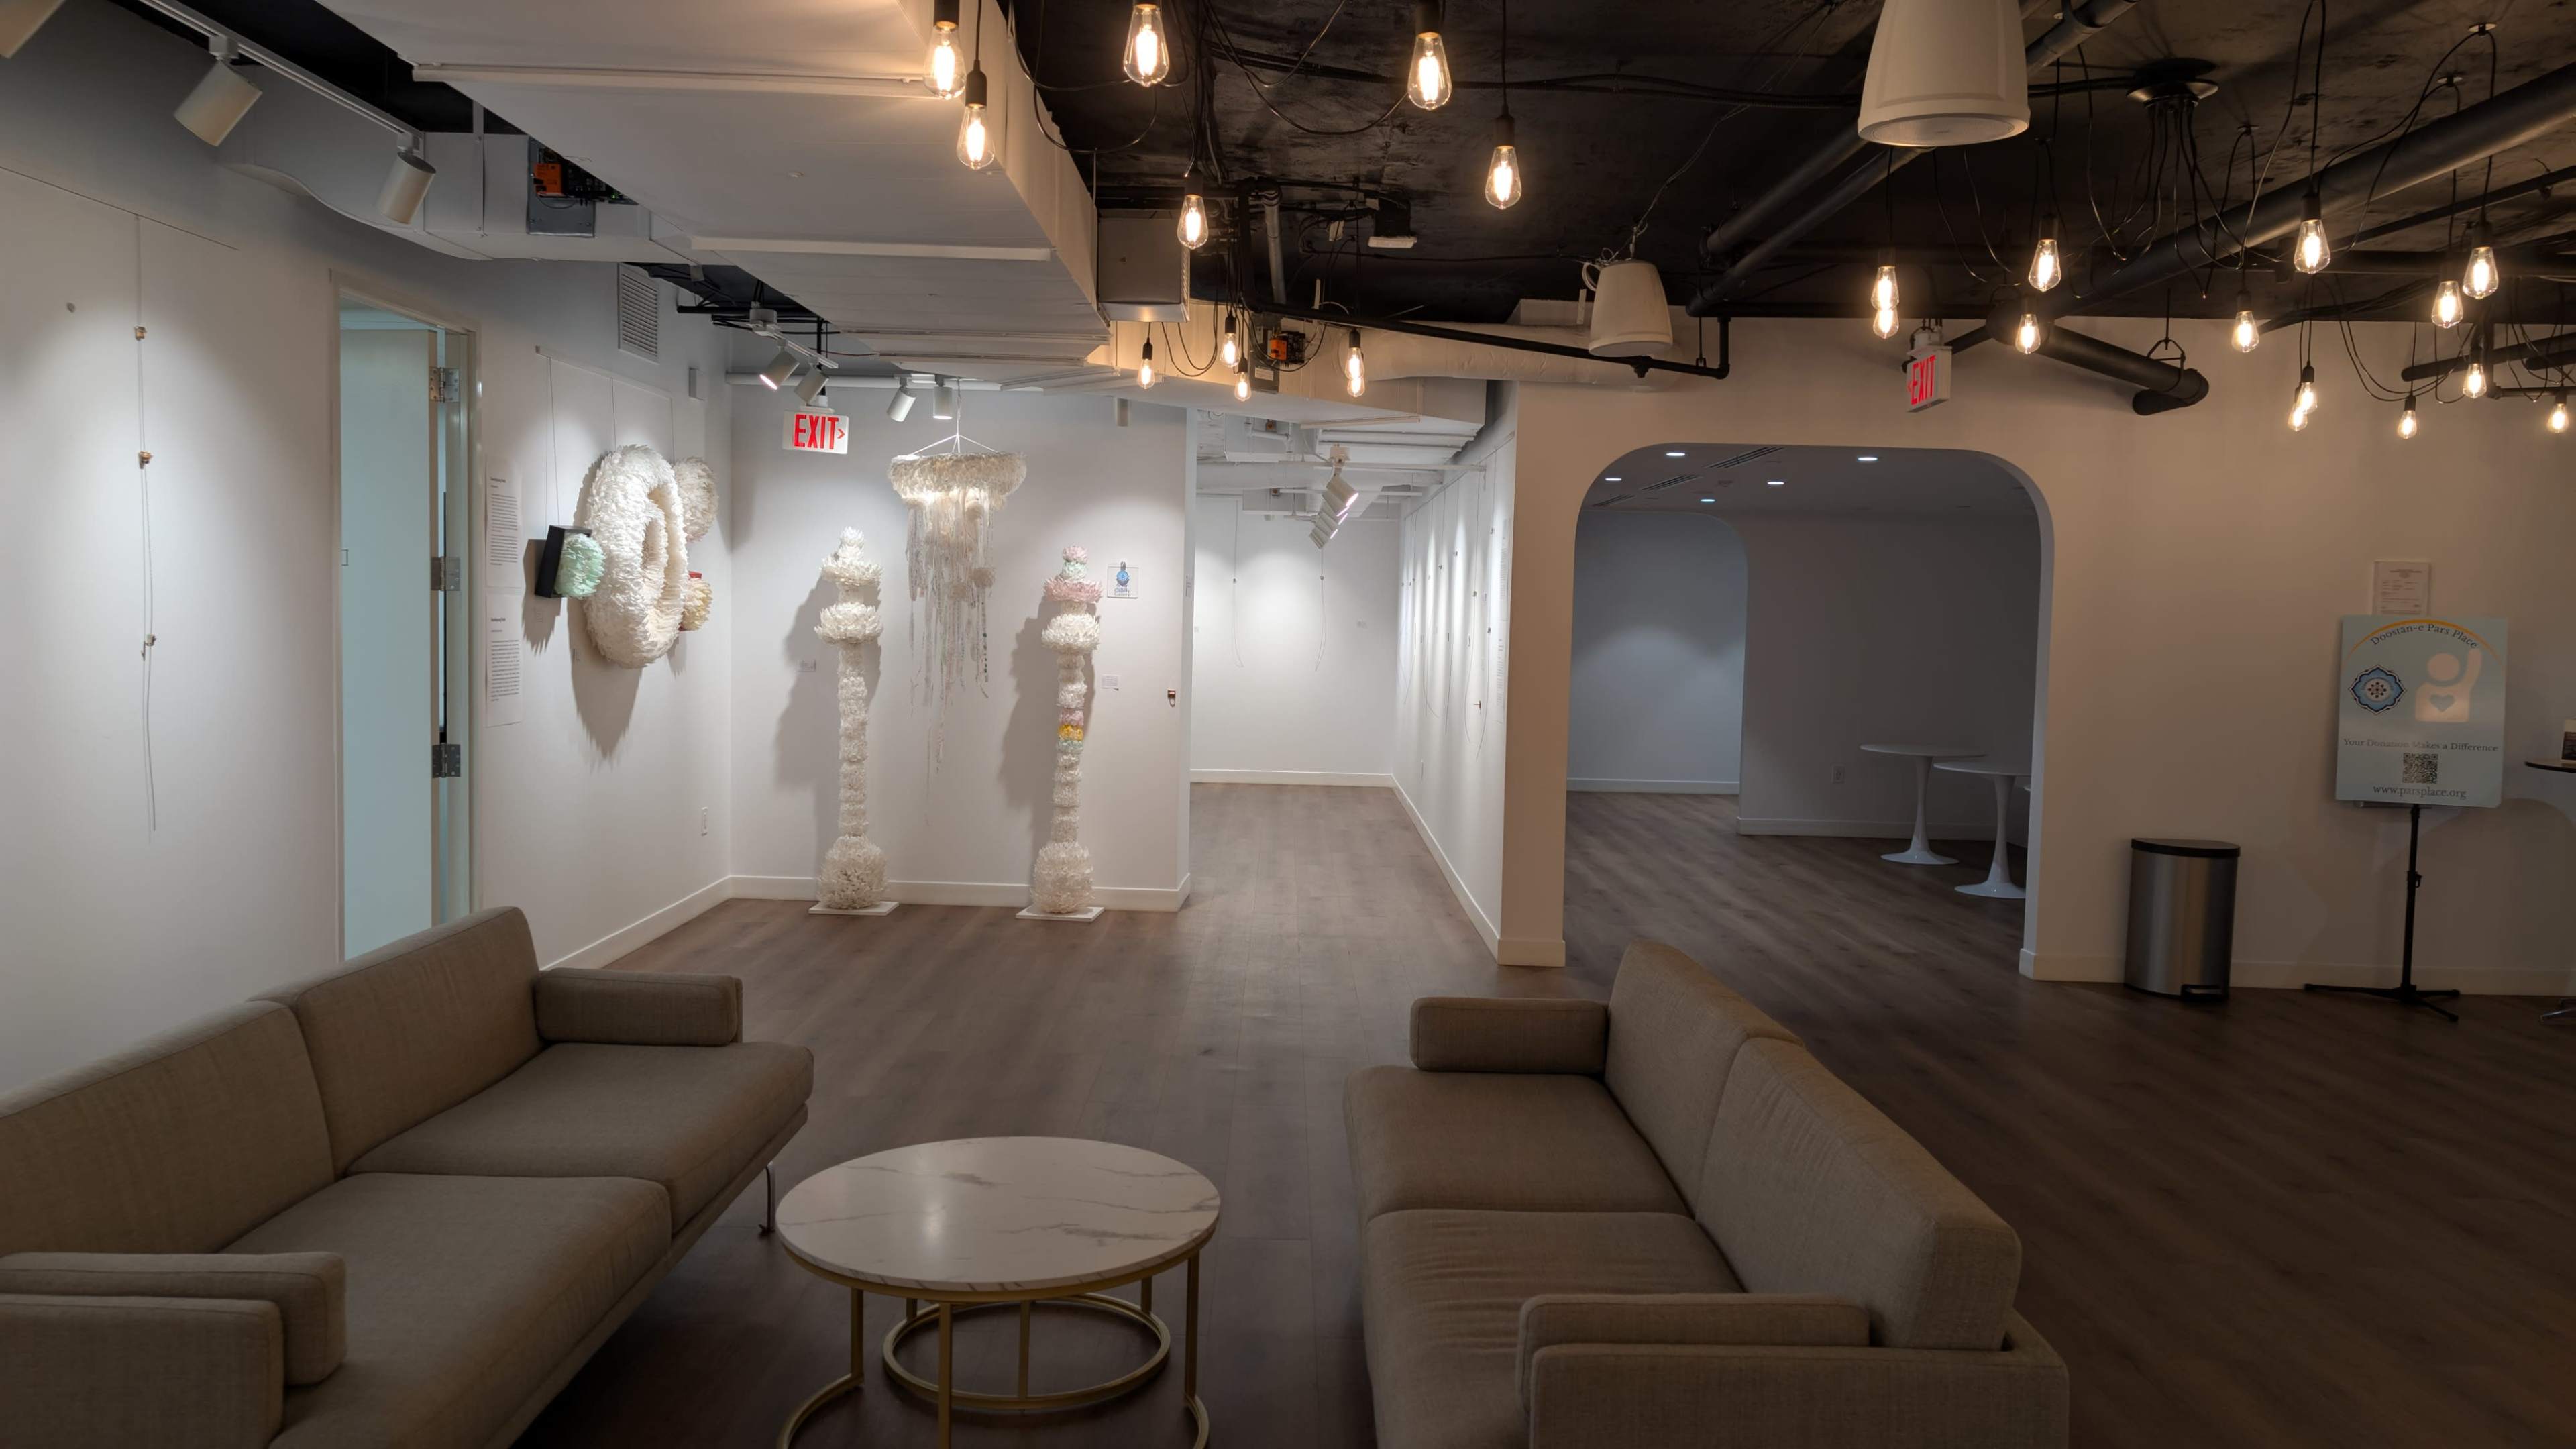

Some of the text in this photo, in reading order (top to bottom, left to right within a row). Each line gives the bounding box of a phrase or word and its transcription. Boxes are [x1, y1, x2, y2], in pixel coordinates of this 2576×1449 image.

[1911, 354, 1936, 405] EXIT
[794, 413, 839, 449] EXIT
[2428, 623, 2449, 635] Pars
[2452, 629, 2477, 649] Place
[2344, 739, 2364, 747] Your
[2367, 739, 2409, 748] Donation
[2450, 743, 2498, 752] Difference
[2373, 786, 2467, 800] www.parsplace.org
